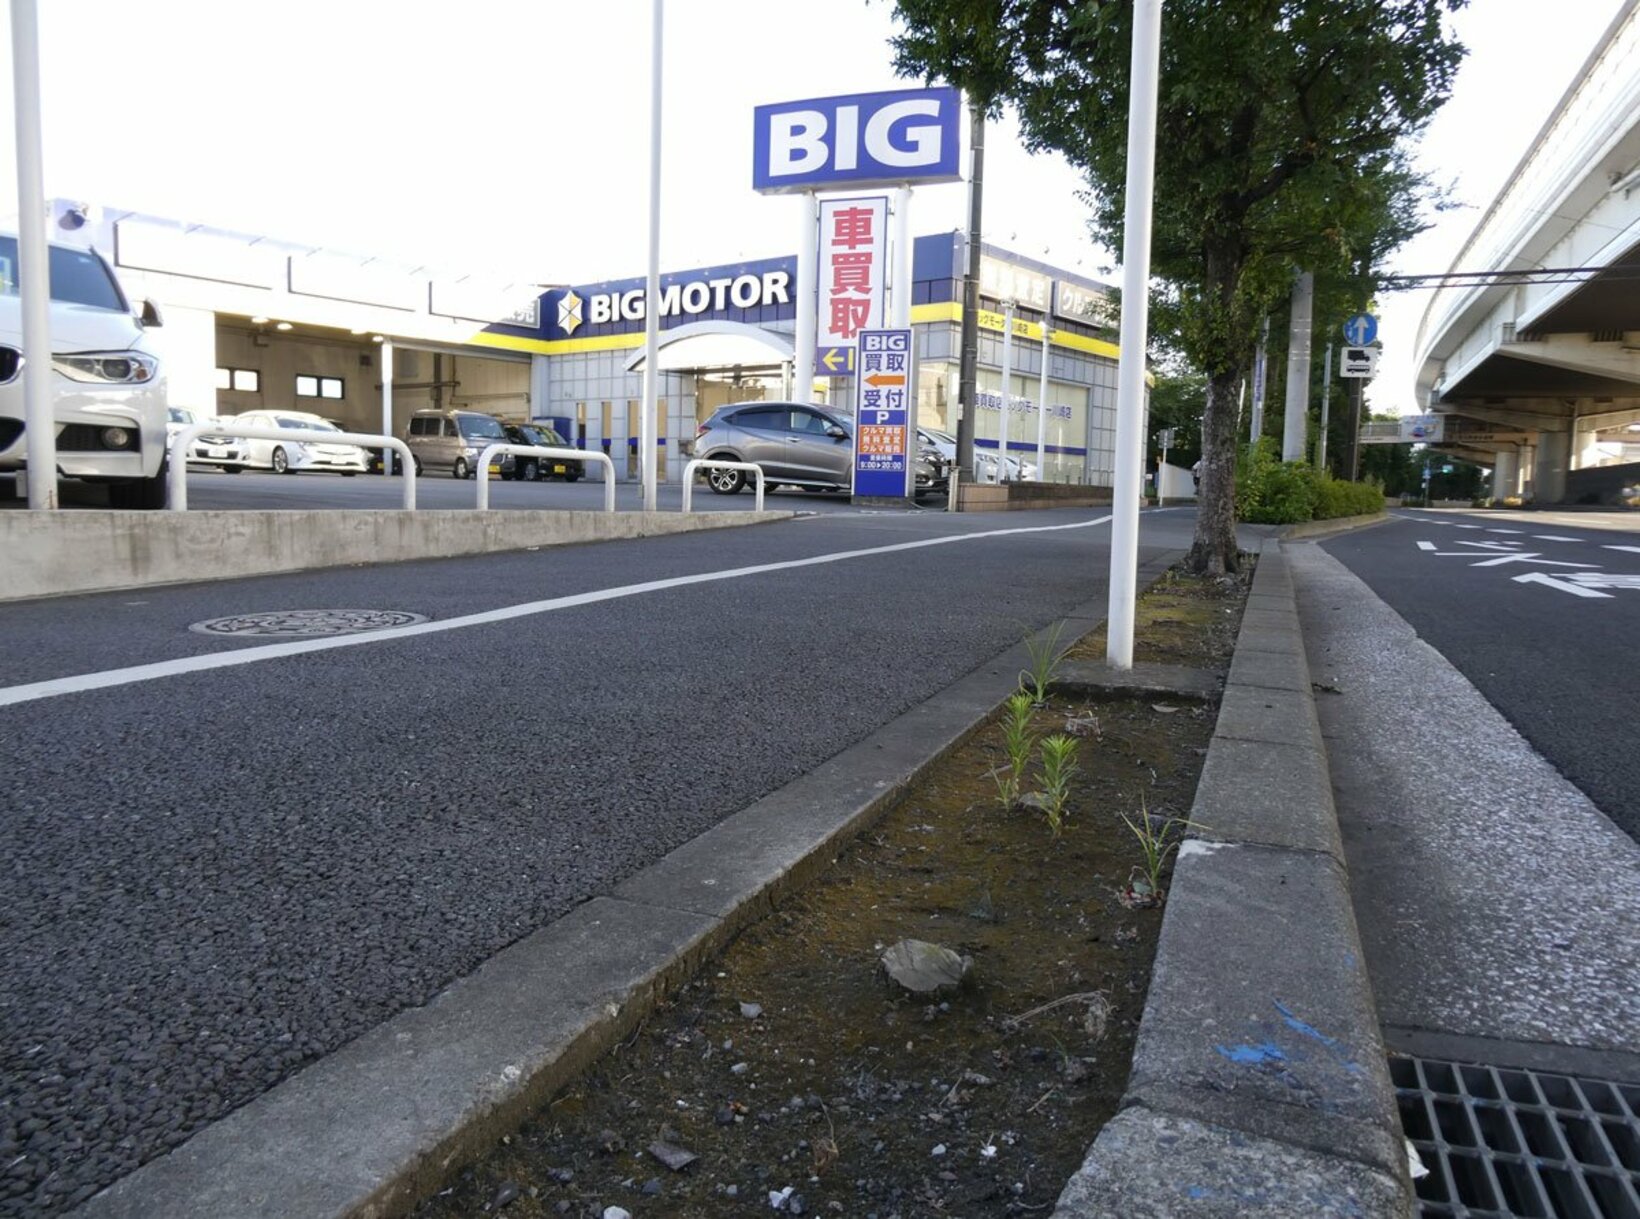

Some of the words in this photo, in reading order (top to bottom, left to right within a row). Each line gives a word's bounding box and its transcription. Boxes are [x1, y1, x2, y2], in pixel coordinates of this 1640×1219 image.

[769, 99, 942, 177] BIG
[829, 207, 874, 339] 車買取
[590, 289, 647, 324] BIG
[656, 271, 789, 317] MOTOR
[866, 335, 905, 350] BIG
[865, 353, 905, 373] 買取
[863, 389, 904, 409] 受付
[876, 411, 890, 425] P
